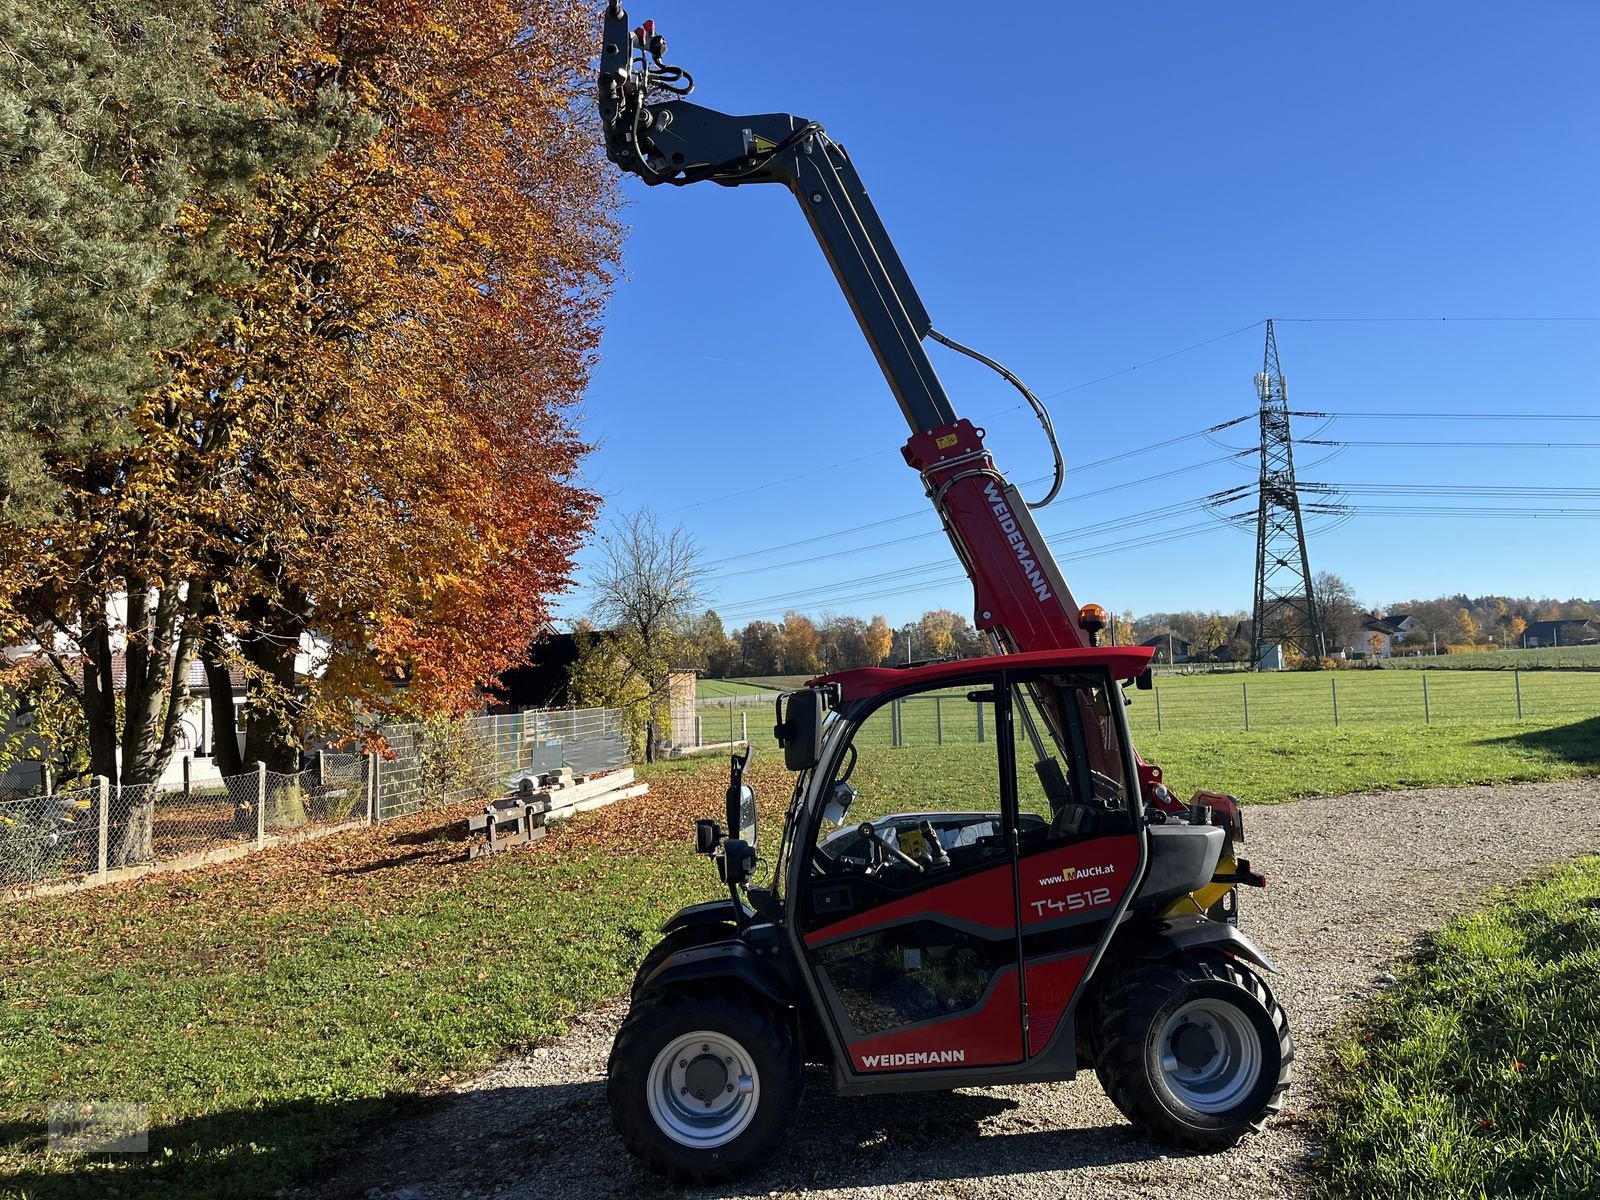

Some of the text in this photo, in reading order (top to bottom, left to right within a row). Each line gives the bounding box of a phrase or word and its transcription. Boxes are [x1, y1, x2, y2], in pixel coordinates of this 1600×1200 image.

[983, 481, 1052, 602] WEIDEMANN
[1039, 864, 1115, 886] www.MAUCH.at
[1031, 887, 1112, 916] T4512
[861, 1050, 965, 1068] WEIDEMANN
